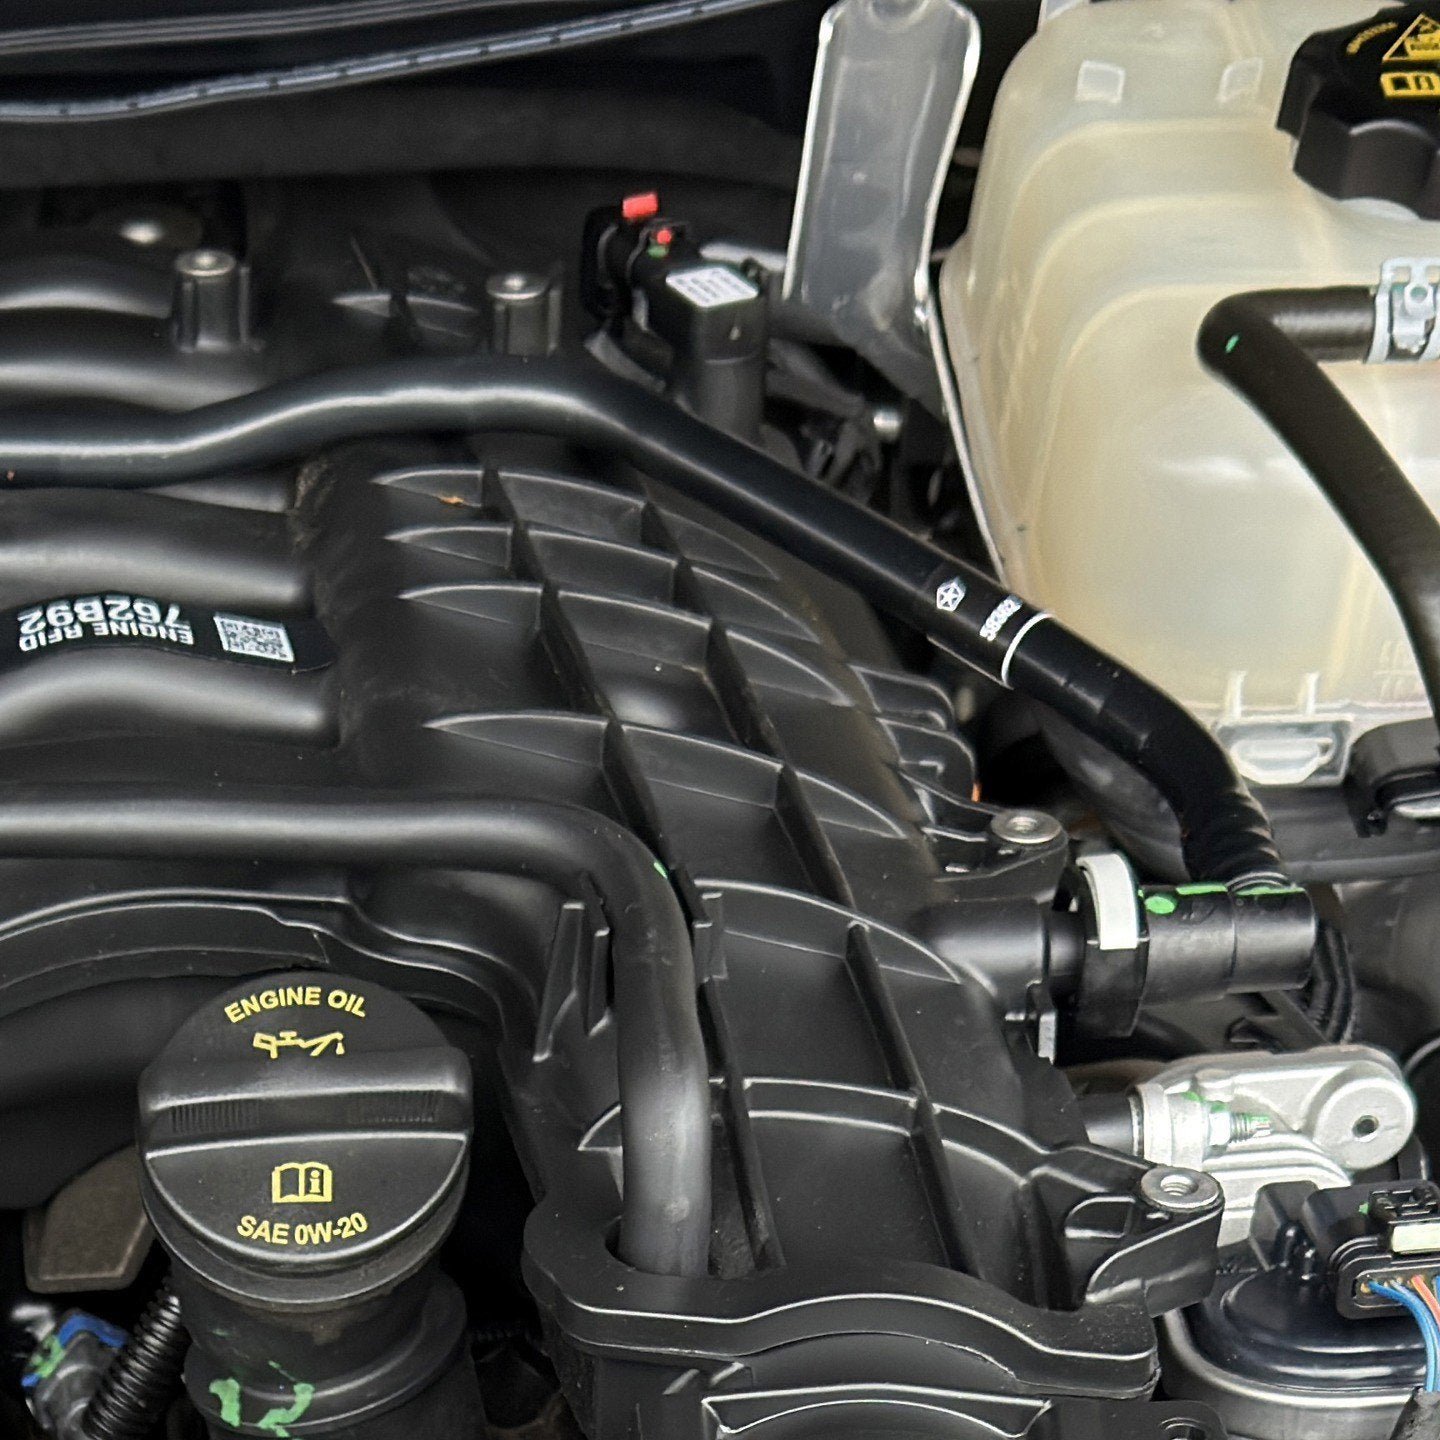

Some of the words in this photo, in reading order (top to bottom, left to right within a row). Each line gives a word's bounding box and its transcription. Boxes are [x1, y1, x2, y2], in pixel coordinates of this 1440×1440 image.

[16, 594, 191, 637] 762B92
[18, 621, 85, 653] RFID
[91, 620, 196, 646] ENGINE
[224, 986, 322, 1024] ENGINE
[327, 989, 367, 1018] OIL
[237, 1214, 291, 1245] SAE
[294, 1212, 369, 1246] 0W-20
